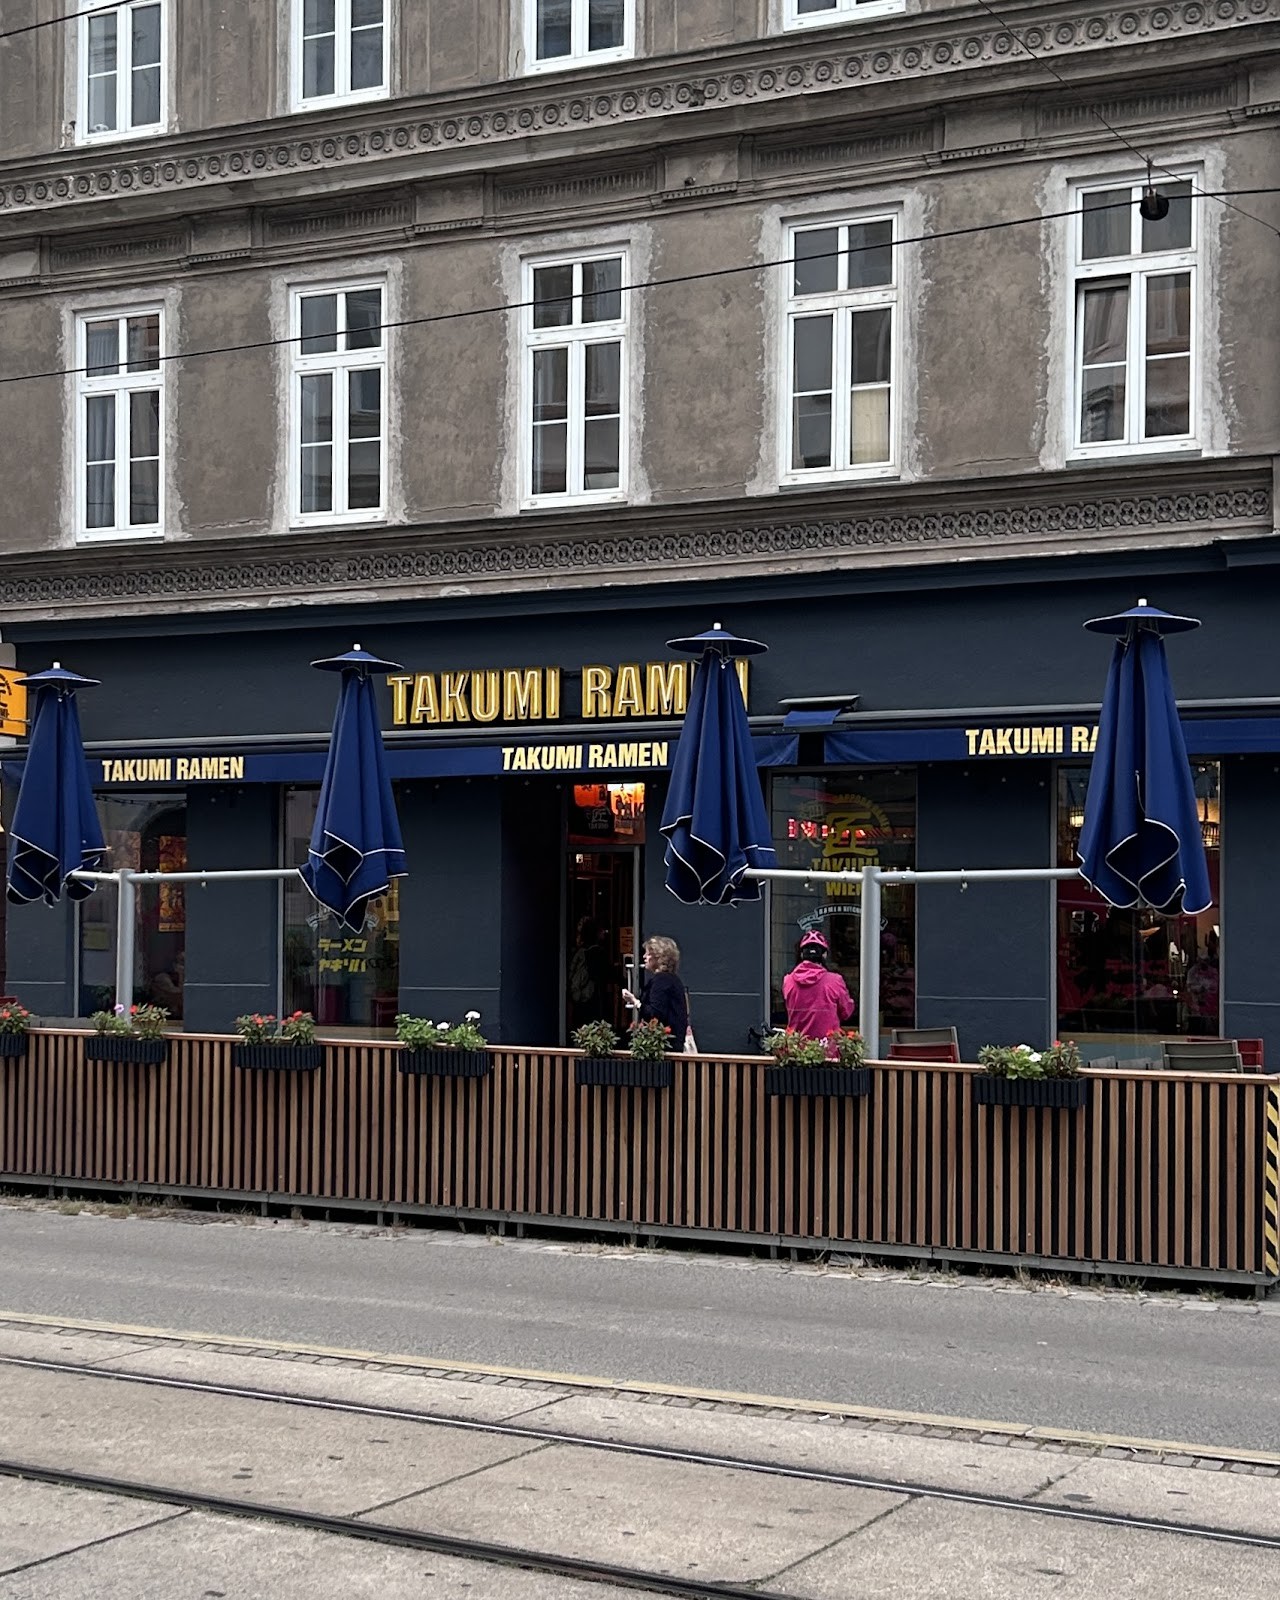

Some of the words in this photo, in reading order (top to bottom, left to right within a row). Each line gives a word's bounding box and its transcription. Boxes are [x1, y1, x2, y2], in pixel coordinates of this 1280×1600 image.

[387, 666, 561, 725] TAKUMI
[582, 657, 749, 718] RAM
[965, 726, 1063, 756] TAKUMI
[102, 758, 171, 782] TAKUMI
[176, 756, 244, 780] RAMEN
[502, 745, 582, 770] TAKUMI
[588, 742, 668, 768] RAMEN
